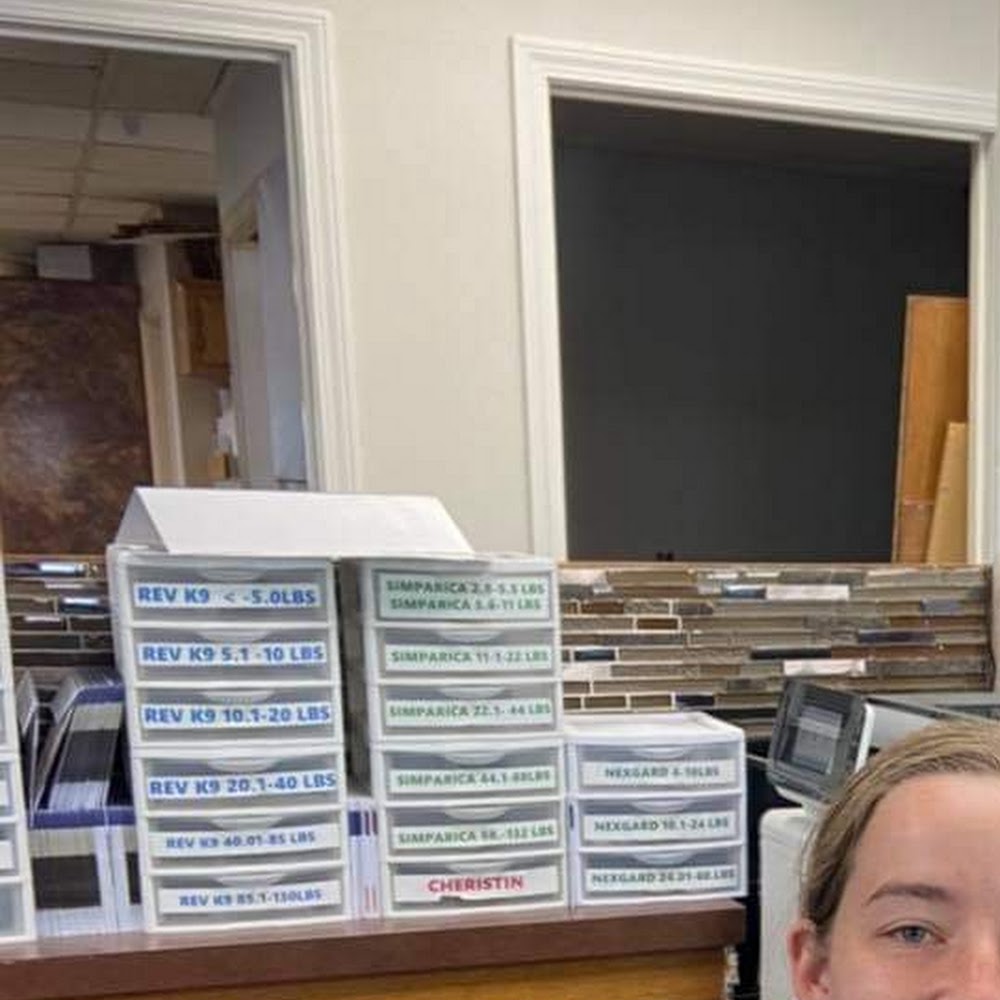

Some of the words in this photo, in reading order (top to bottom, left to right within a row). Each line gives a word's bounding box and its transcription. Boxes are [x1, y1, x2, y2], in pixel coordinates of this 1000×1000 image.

[138, 586, 177, 602] REV
[184, 588, 210, 603] K9
[386, 580, 467, 594] SIMPARICA
[521, 583, 545, 595] LBS
[390, 599, 471, 610] SIMPARICA
[518, 599, 541, 610] LBS
[142, 647, 182, 661] REV
[189, 647, 215, 661] K9
[290, 646, 323, 660] LBS
[390, 651, 471, 662] SIMPARICA
[525, 650, 549, 662] LBS
[144, 708, 182, 723] REV
[190, 708, 216, 722] K9
[223, 706, 291, 723] 10.1-20
[297, 705, 330, 721] LBS
[389, 705, 469, 717] SIMPARICA
[528, 703, 551, 715] LBS
[605, 765, 669, 777] NEXGARD
[150, 780, 187, 795] REV
[195, 779, 220, 795] K9
[227, 775, 297, 793] 20.1-40
[303, 772, 336, 788] LBS
[396, 773, 475, 786] SIMPARICA
[594, 820, 659, 832] NEXGARD
[707, 817, 729, 828] LBS
[166, 837, 194, 849] REV
[200, 837, 218, 848] K9
[290, 831, 316, 844] LBS
[399, 830, 476, 843] SIMPARICA
[531, 824, 554, 836] LBS
[428, 875, 523, 892] CHERISTIN
[591, 871, 656, 883] NEXGARD
[179, 895, 208, 907] REV
[213, 894, 232, 906] K9
